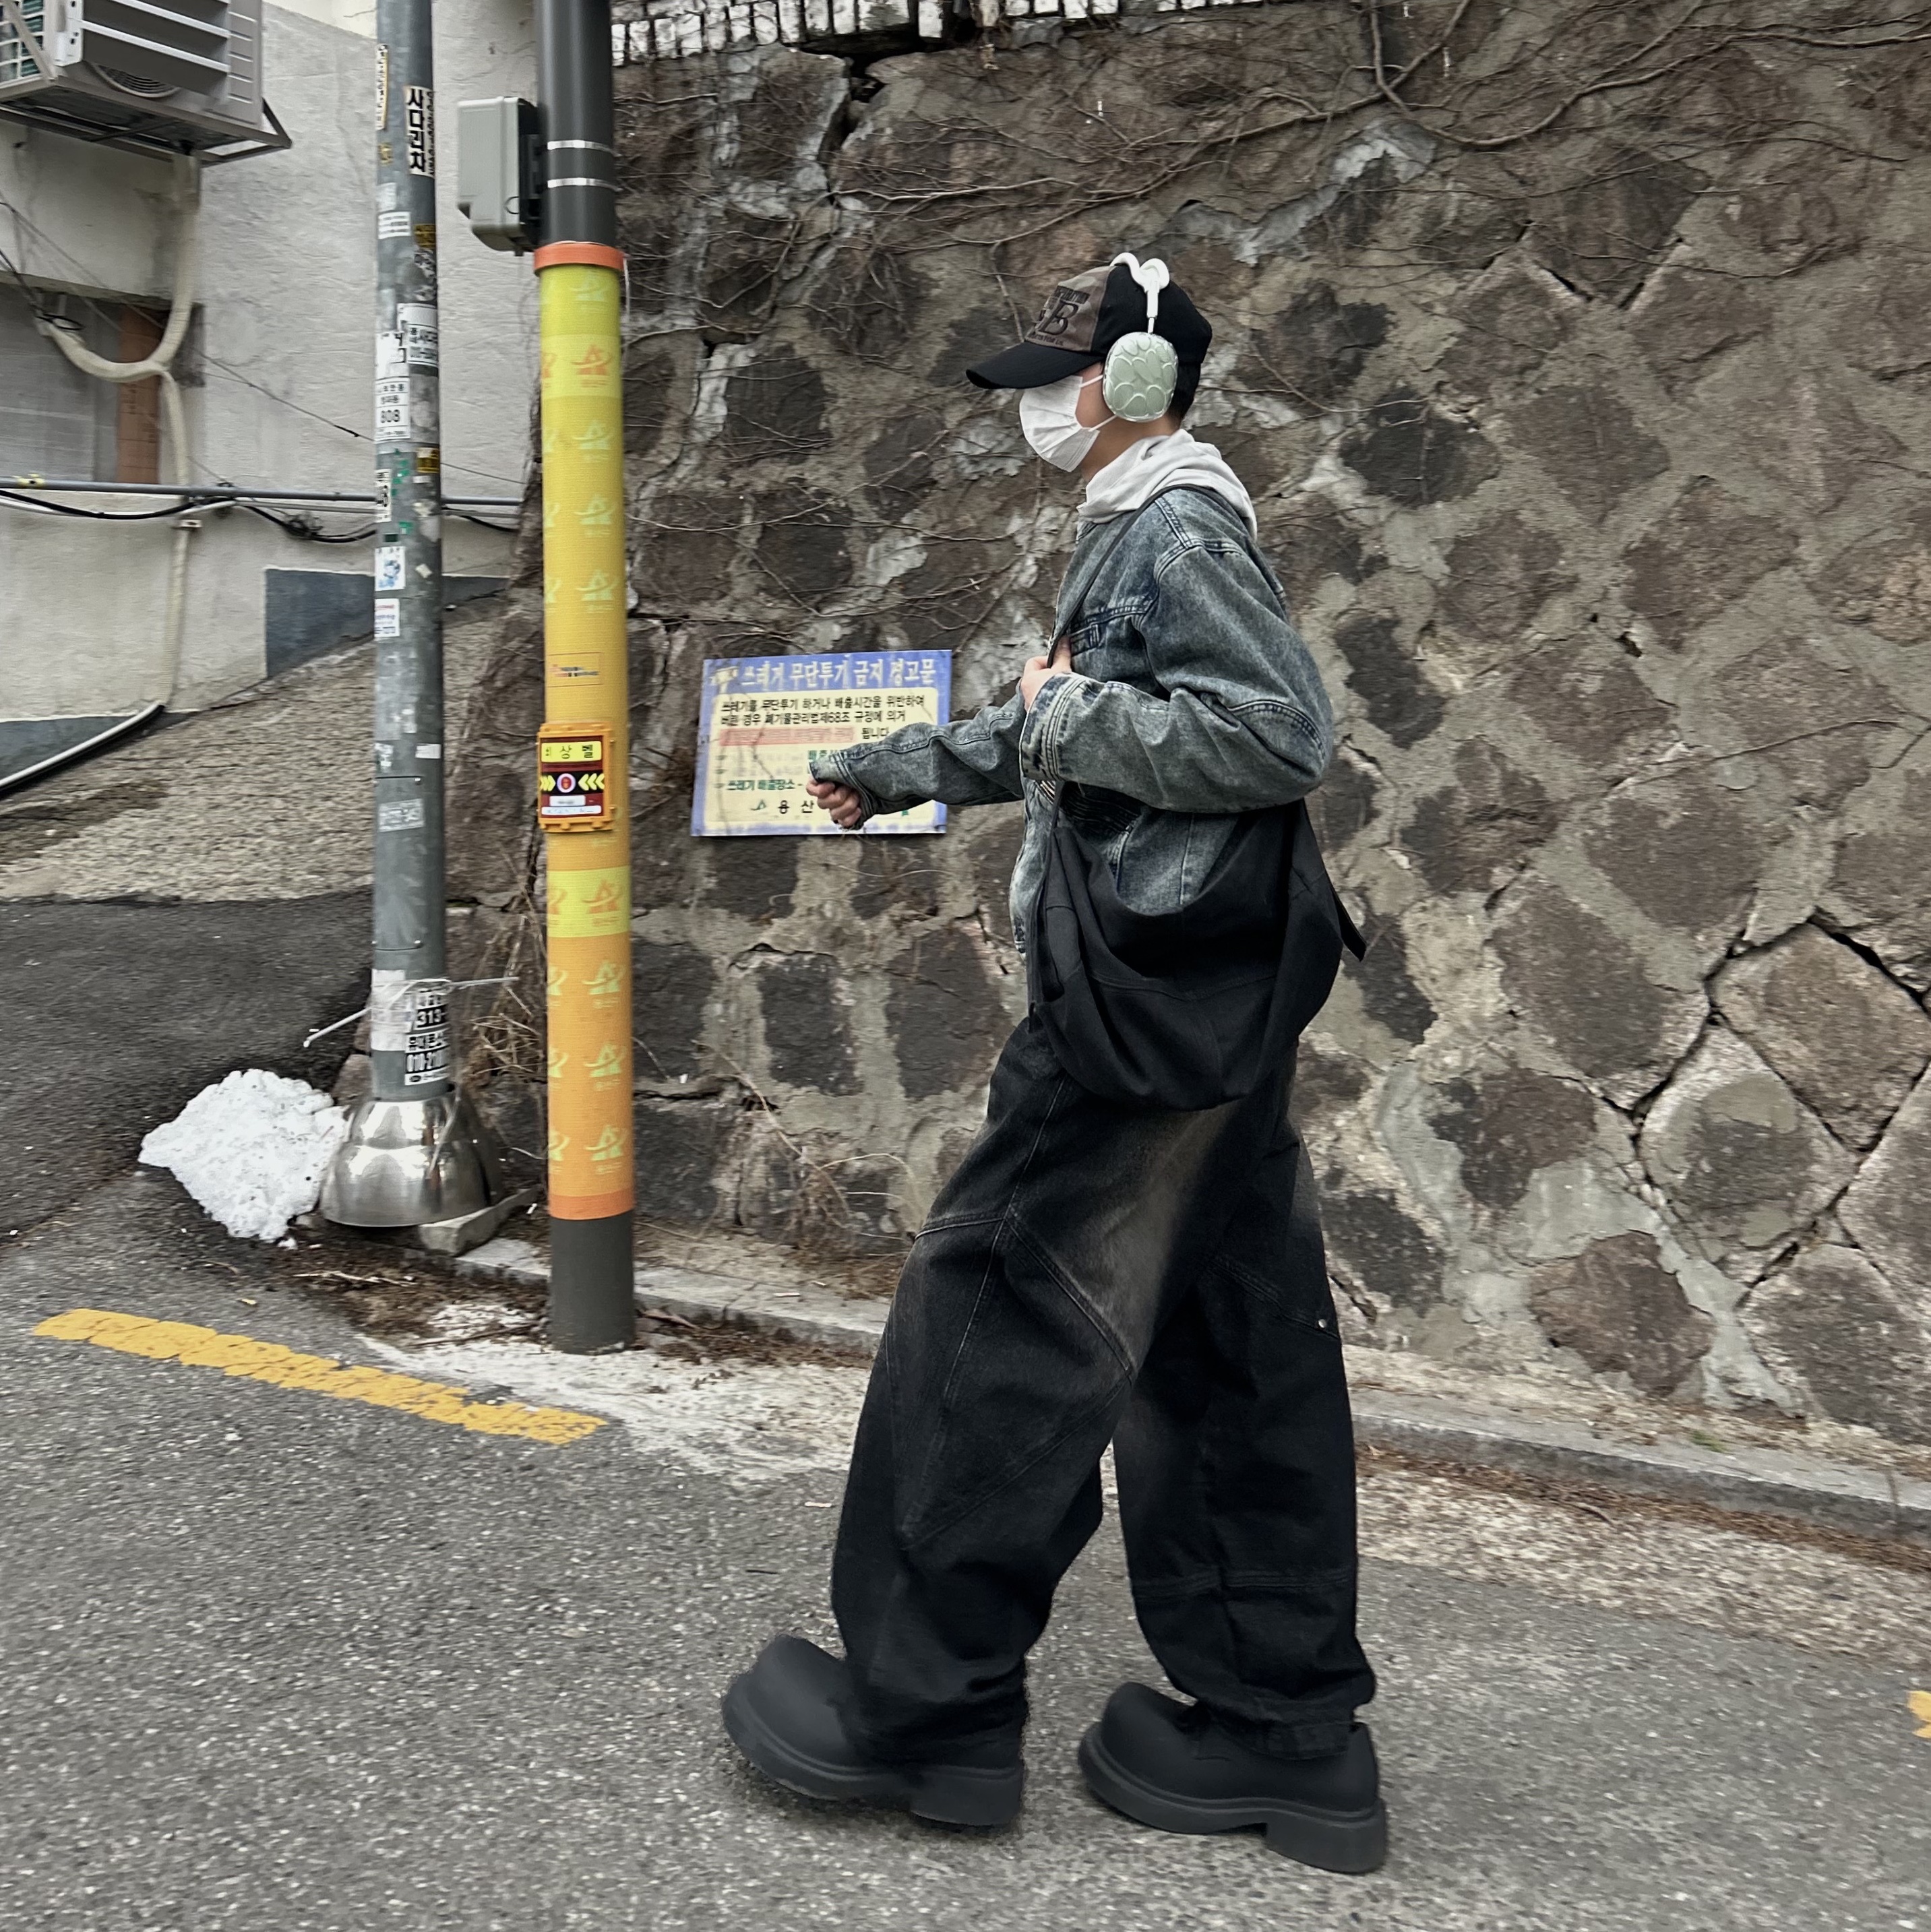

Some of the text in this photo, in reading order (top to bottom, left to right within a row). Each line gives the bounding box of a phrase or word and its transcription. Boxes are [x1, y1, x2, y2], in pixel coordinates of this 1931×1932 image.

[741, 658, 937, 691] 쓰레기 무단투기 금지 경고문
[762, 698, 798, 712] 무단투기
[802, 697, 831, 710] 하거나
[834, 695, 882, 709] 배출시간을
[886, 695, 925, 708] 위반하여
[743, 713, 761, 726] 경우
[854, 710, 882, 724] 규정에
[886, 710, 907, 723] 의거
